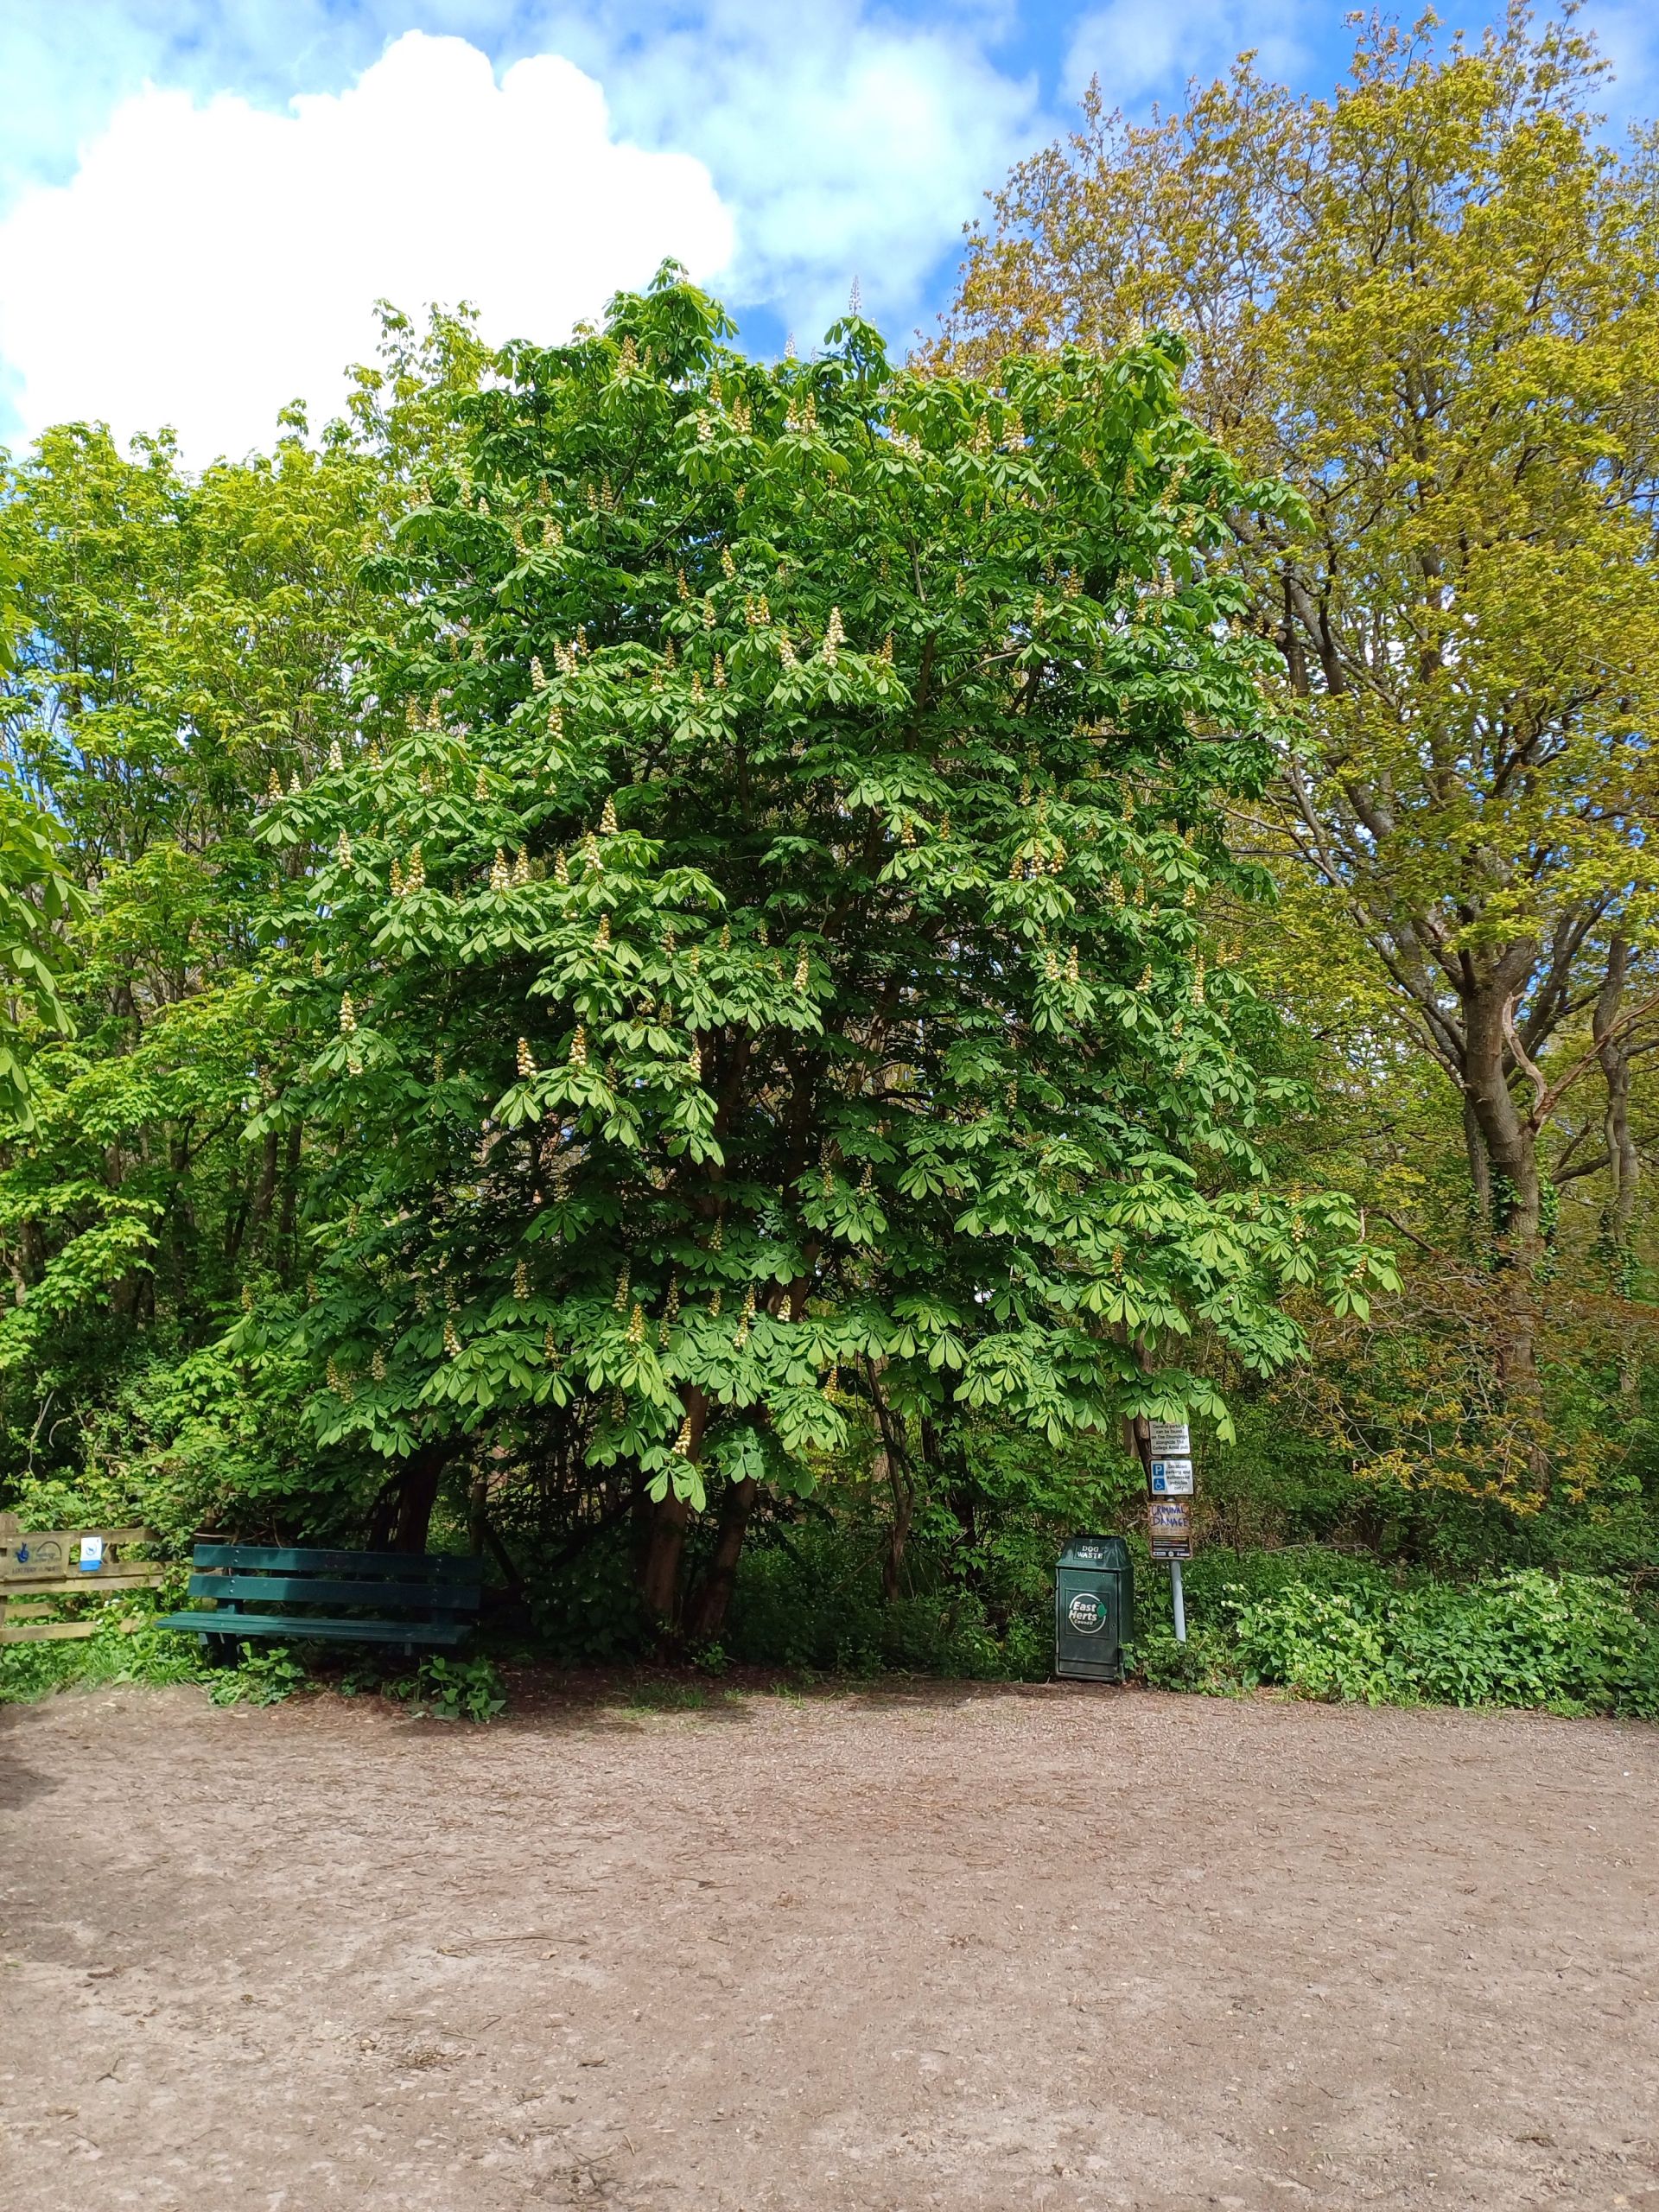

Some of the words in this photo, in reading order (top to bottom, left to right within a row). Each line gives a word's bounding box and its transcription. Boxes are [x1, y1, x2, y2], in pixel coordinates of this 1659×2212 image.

[1155, 1465, 1162, 1475] P
[1151, 1504, 1186, 1516] CRIMINAL
[1151, 1516, 1188, 1527] DAMAGE
[1073, 1601, 1096, 1612] East
[1068, 1610, 1097, 1621] Herts
